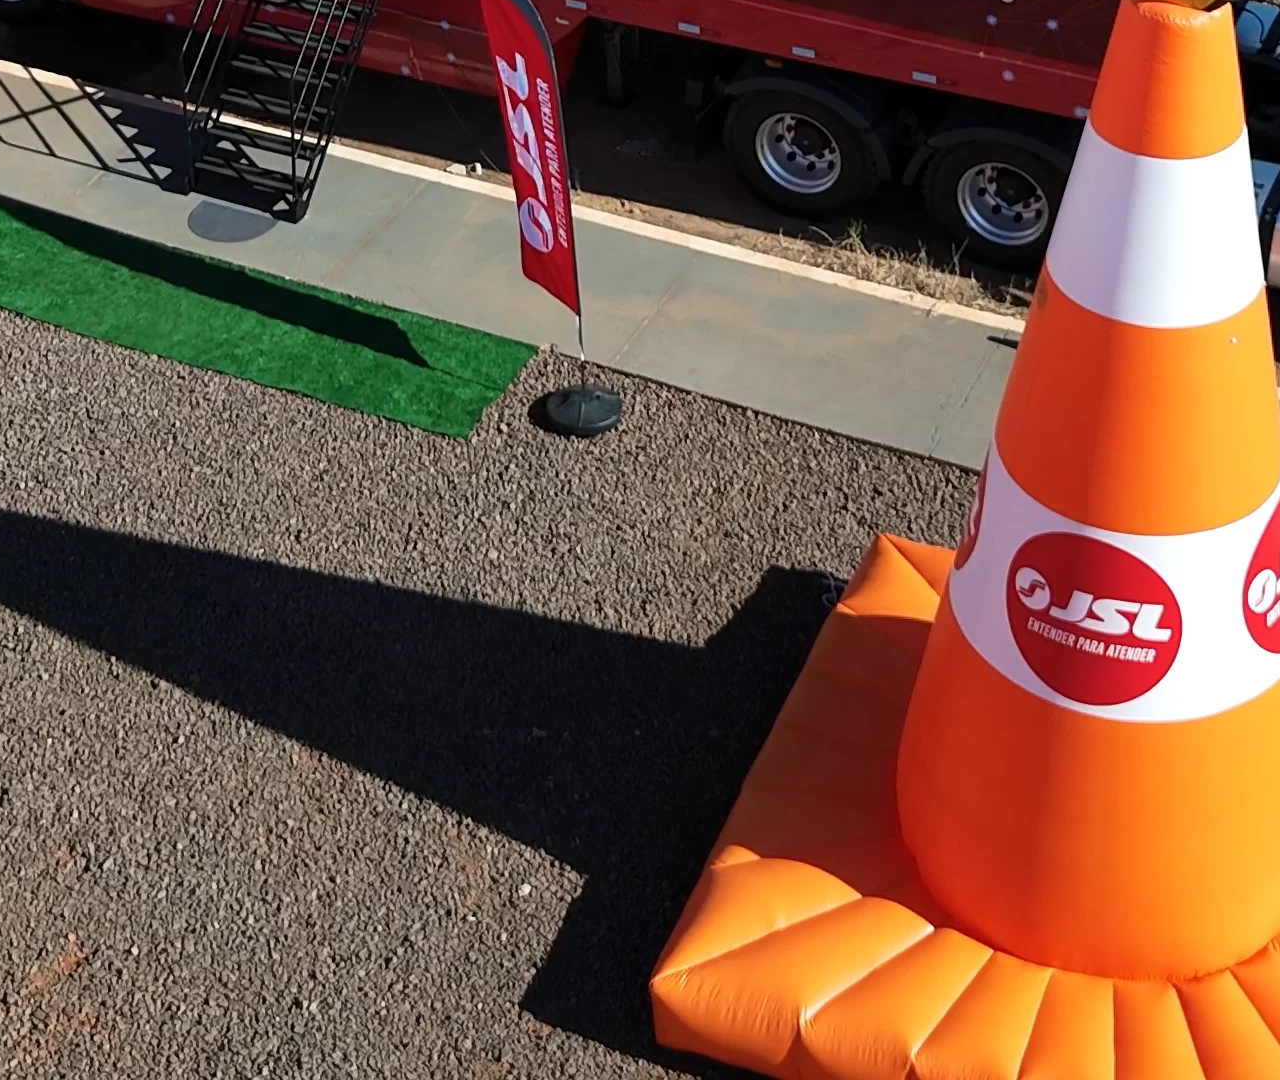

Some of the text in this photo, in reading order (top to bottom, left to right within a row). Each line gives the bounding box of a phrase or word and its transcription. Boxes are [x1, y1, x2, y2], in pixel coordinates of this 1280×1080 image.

[495, 51, 548, 207] JSL
[535, 77, 569, 249] ENTENDER PARA ATENDER
[1026, 616, 1157, 664] ENTENDER PARA ATENDER
[1048, 589, 1172, 643] JSL
